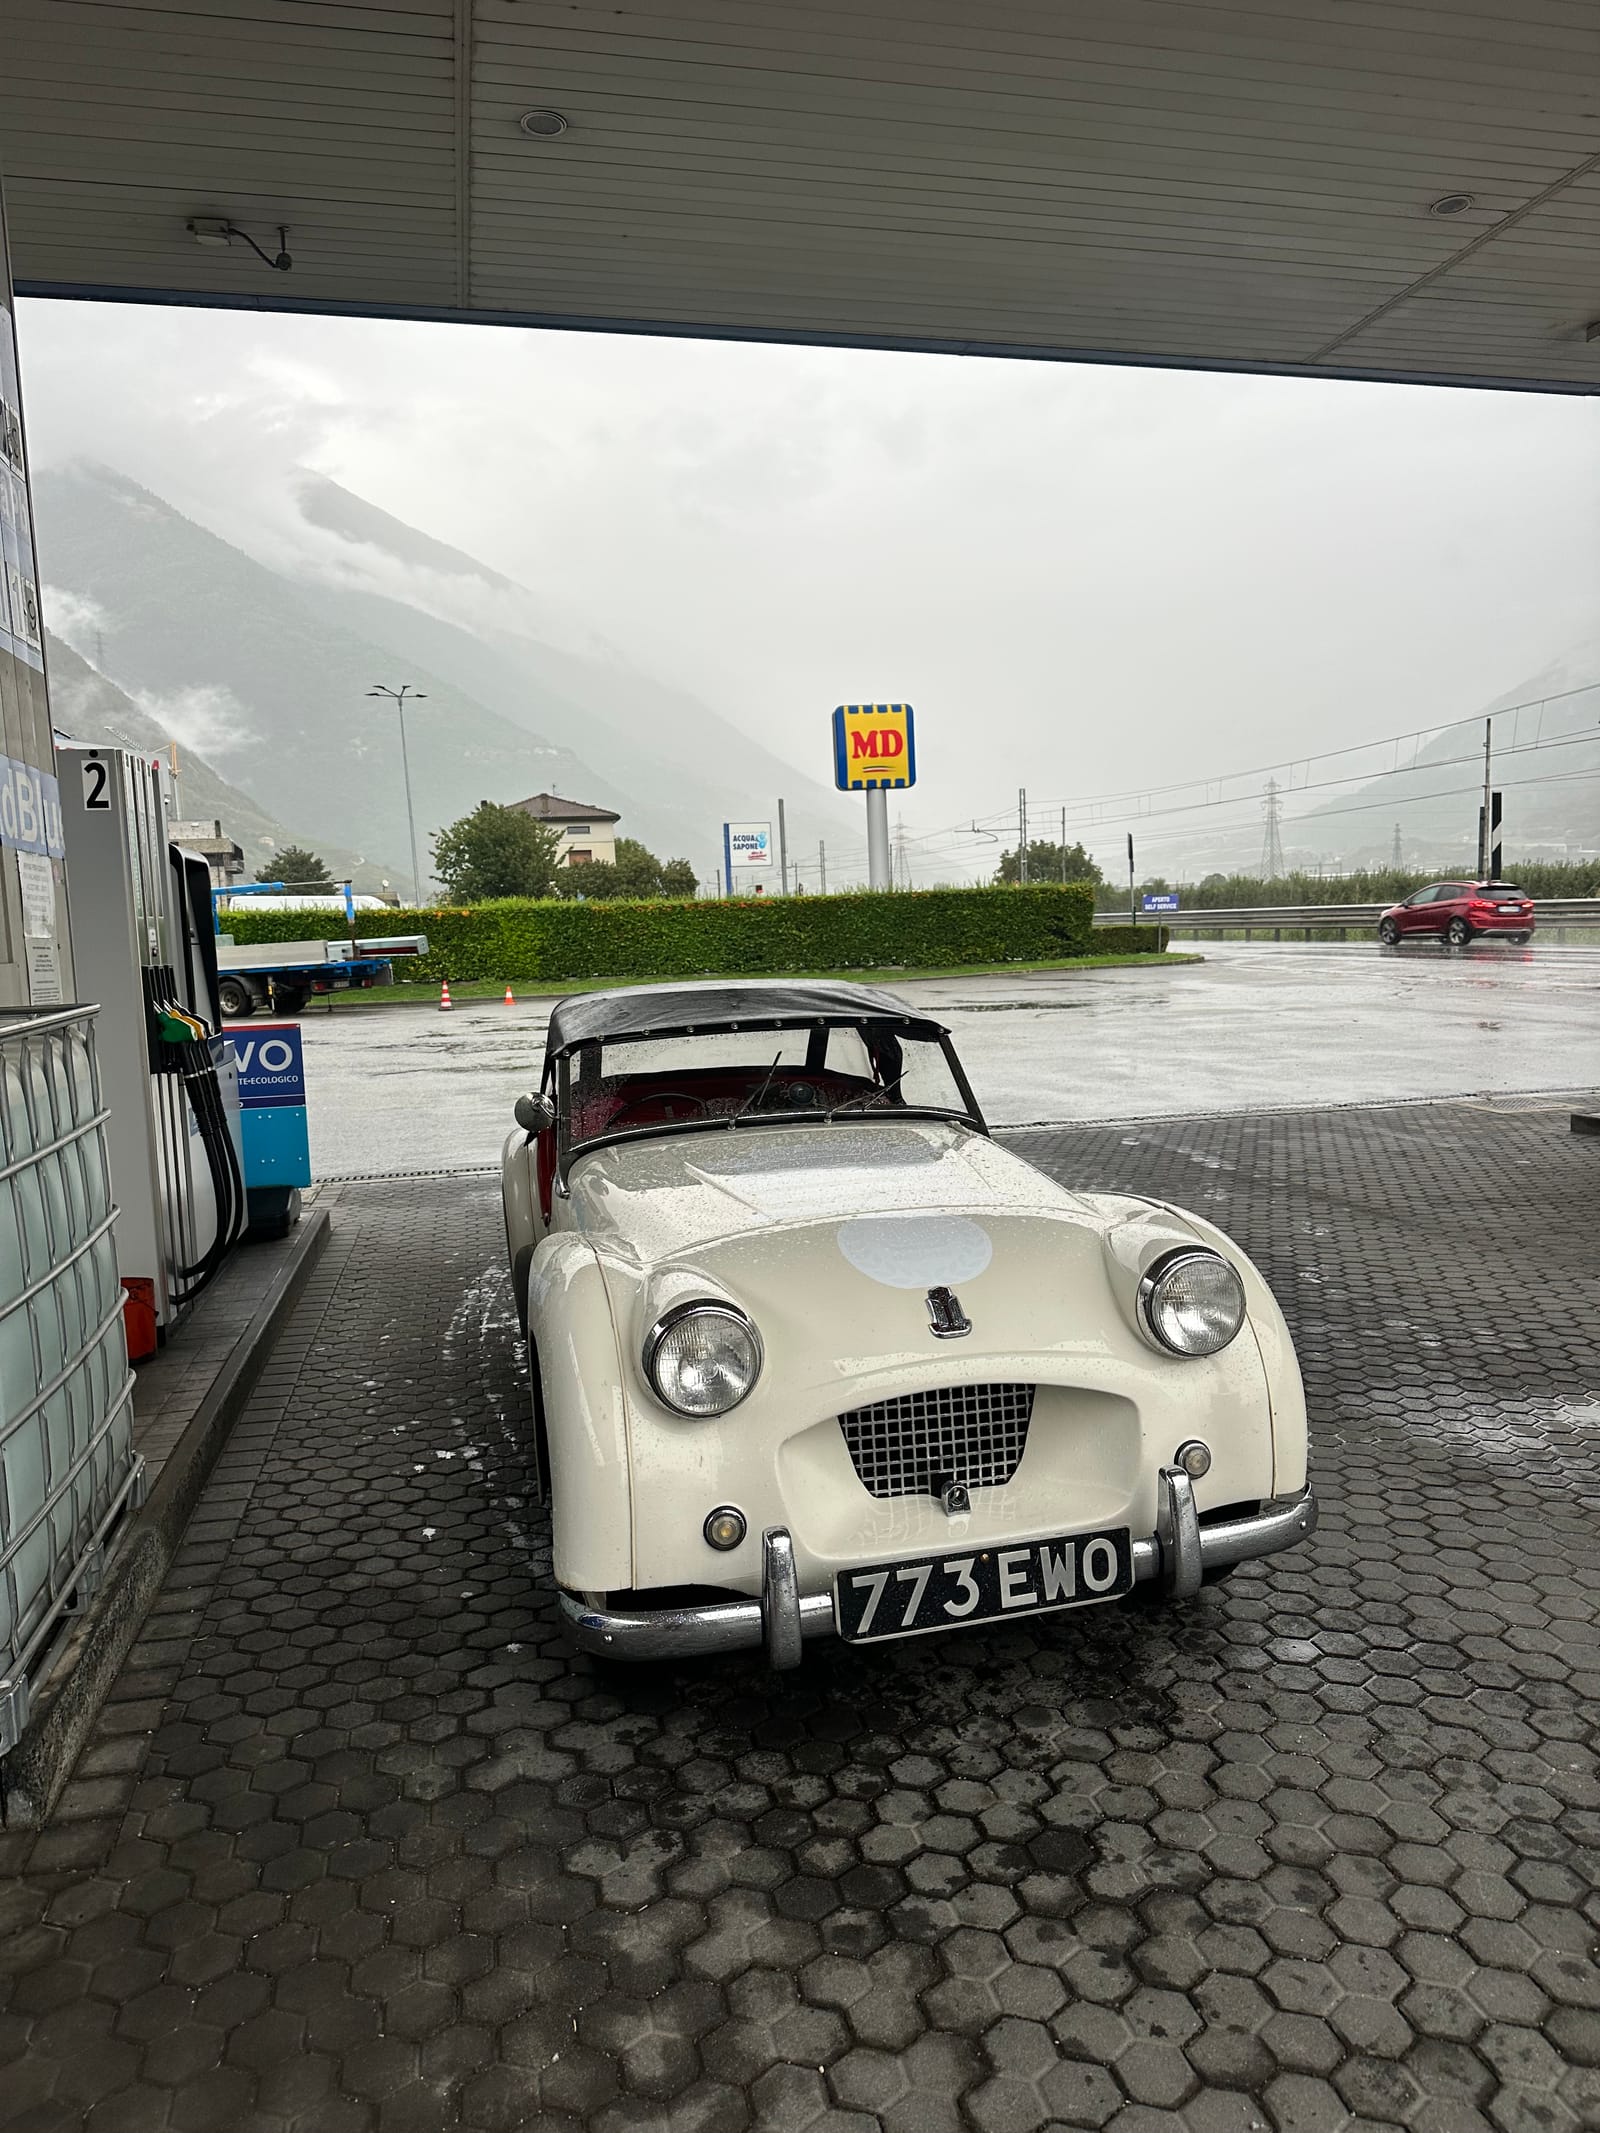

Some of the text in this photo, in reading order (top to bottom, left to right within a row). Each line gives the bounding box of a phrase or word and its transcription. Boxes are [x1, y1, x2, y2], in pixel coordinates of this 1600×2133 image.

[851, 729, 904, 759] MD
[84, 762, 110, 809] 2
[0, 768, 65, 849] dBlu
[733, 834, 755, 842] ACQUA
[733, 842, 758, 850] SAPONE
[851, 1537, 1119, 1634] 773 EWO
